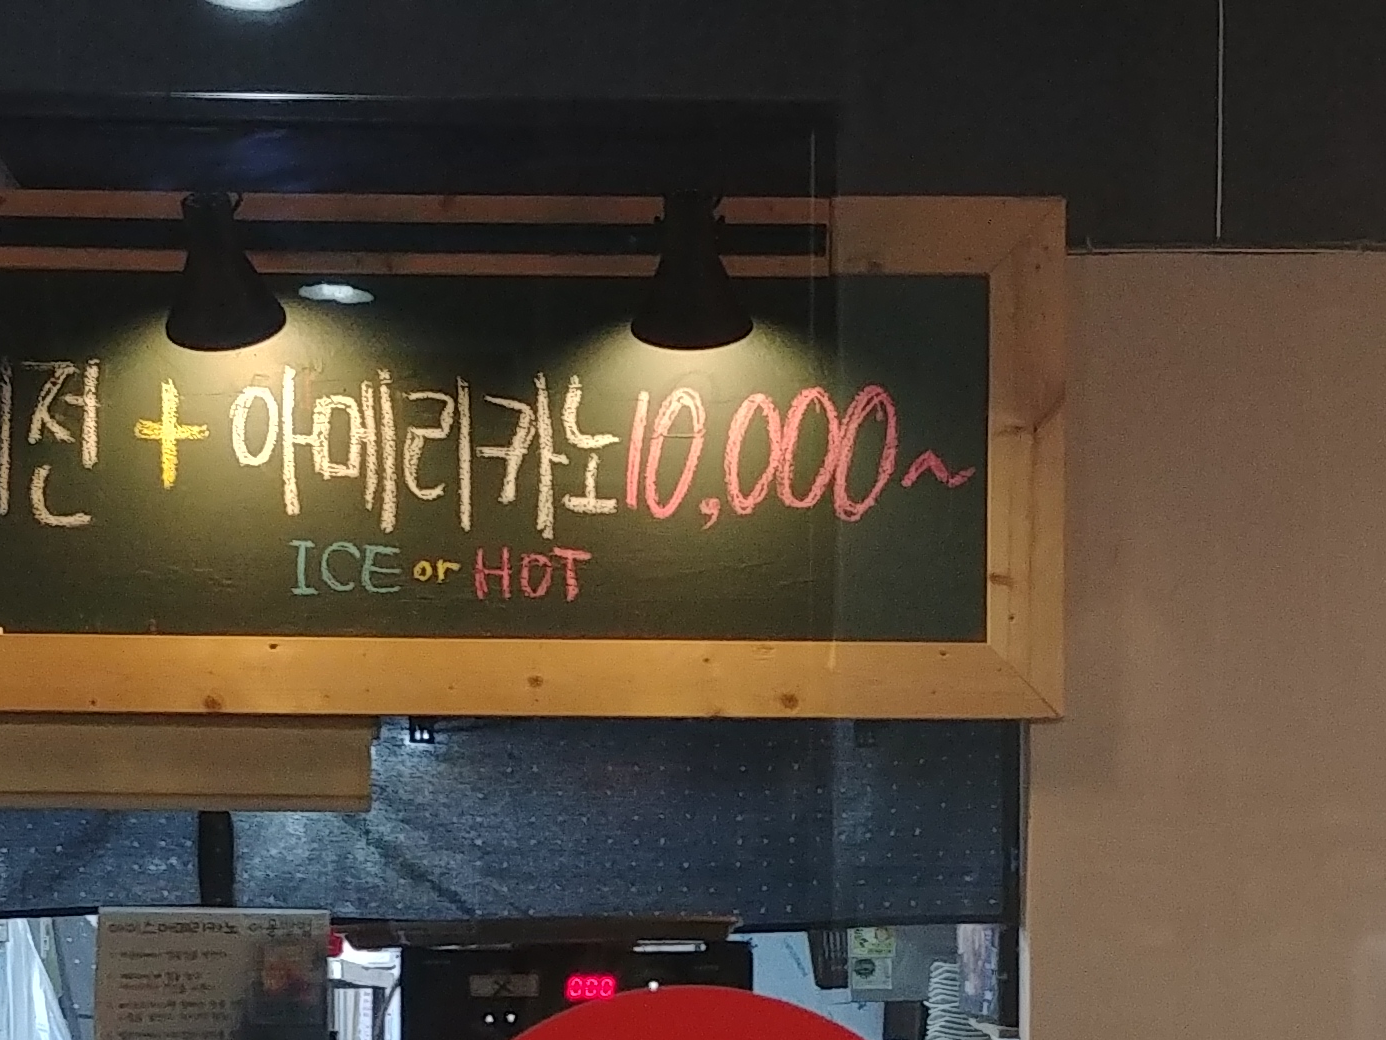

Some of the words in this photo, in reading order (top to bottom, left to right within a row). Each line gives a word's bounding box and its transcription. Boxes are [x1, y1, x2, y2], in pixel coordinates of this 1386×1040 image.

[229, 364, 617, 541] 아메리카노
[290, 540, 401, 598] ICE
[412, 556, 461, 584] or
[474, 548, 591, 602] HOT
